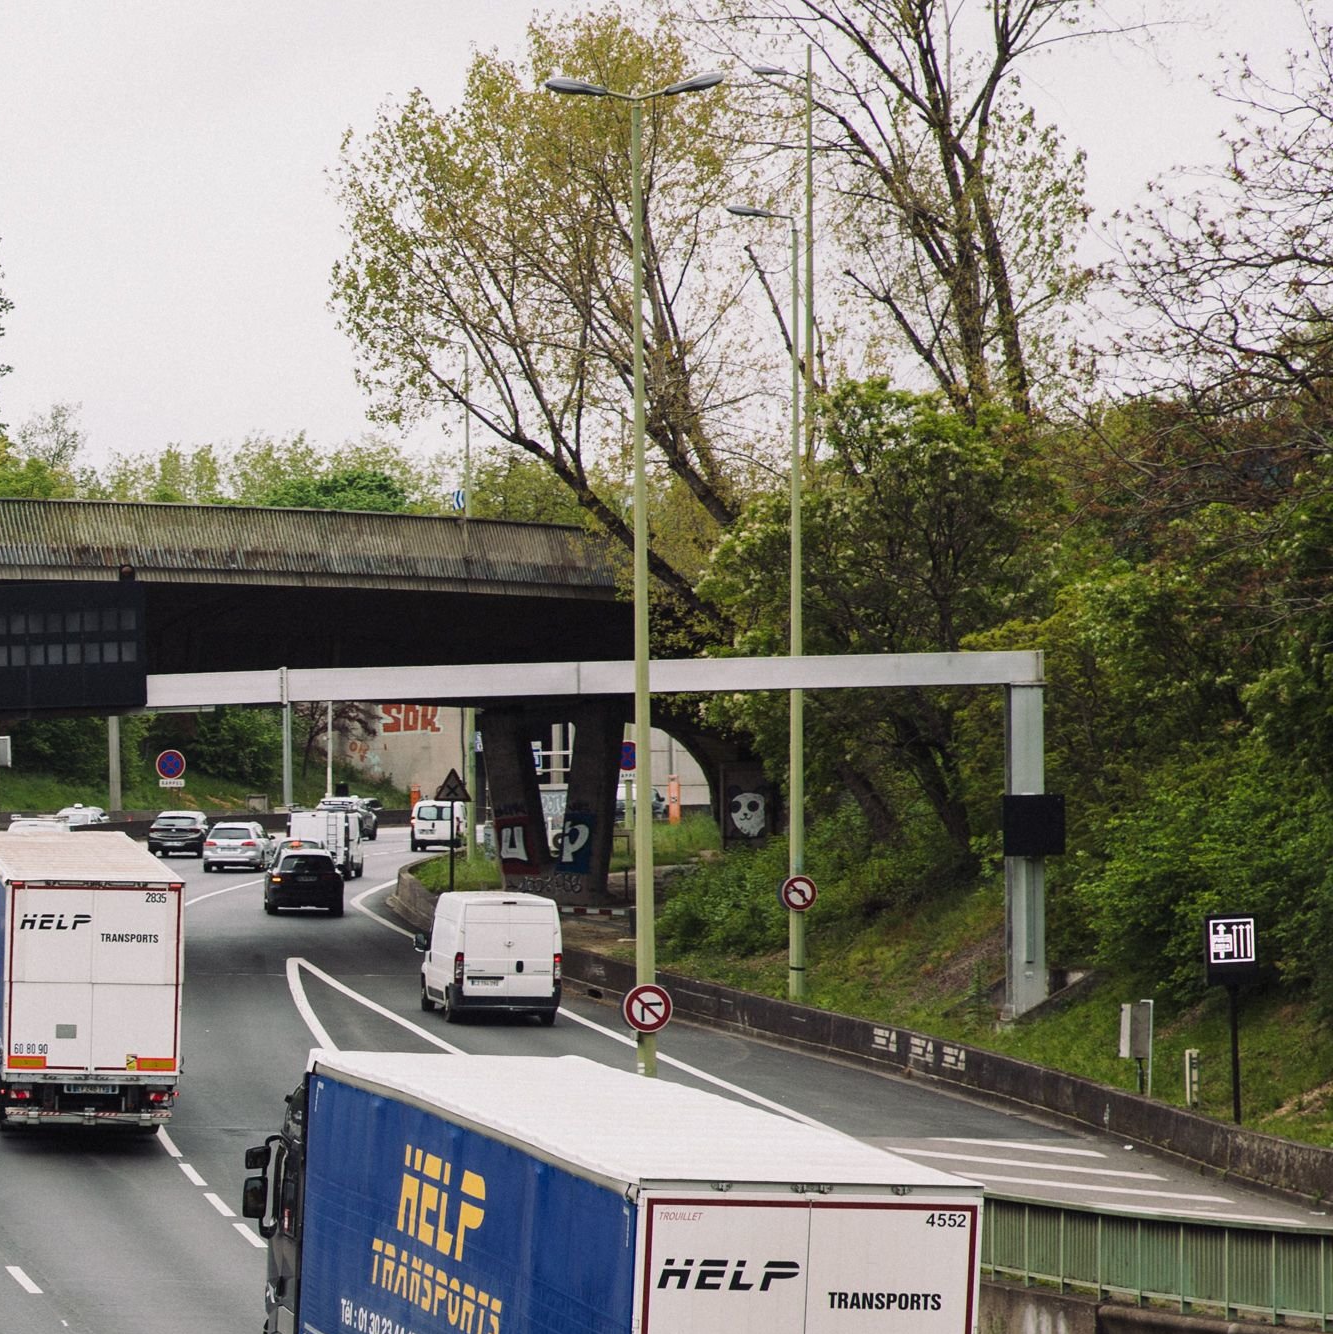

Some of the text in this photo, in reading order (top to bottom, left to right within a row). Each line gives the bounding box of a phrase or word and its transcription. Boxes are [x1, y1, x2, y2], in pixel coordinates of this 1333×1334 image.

[145, 892, 167, 904] 2835
[20, 914, 92, 930] HELP
[101, 932, 159, 944] TRANSPORTS
[14, 1043, 48, 1055] 60 80 90
[396, 1144, 486, 1262] HELP
[659, 1211, 704, 1222] TROUILLET
[926, 1213, 967, 1228] 4552
[657, 1258, 800, 1291] HELP
[828, 1292, 942, 1311] TRANSPORTS
[341, 1298, 353, 1326] Tél
[358, 1307, 368, 1333] 01
